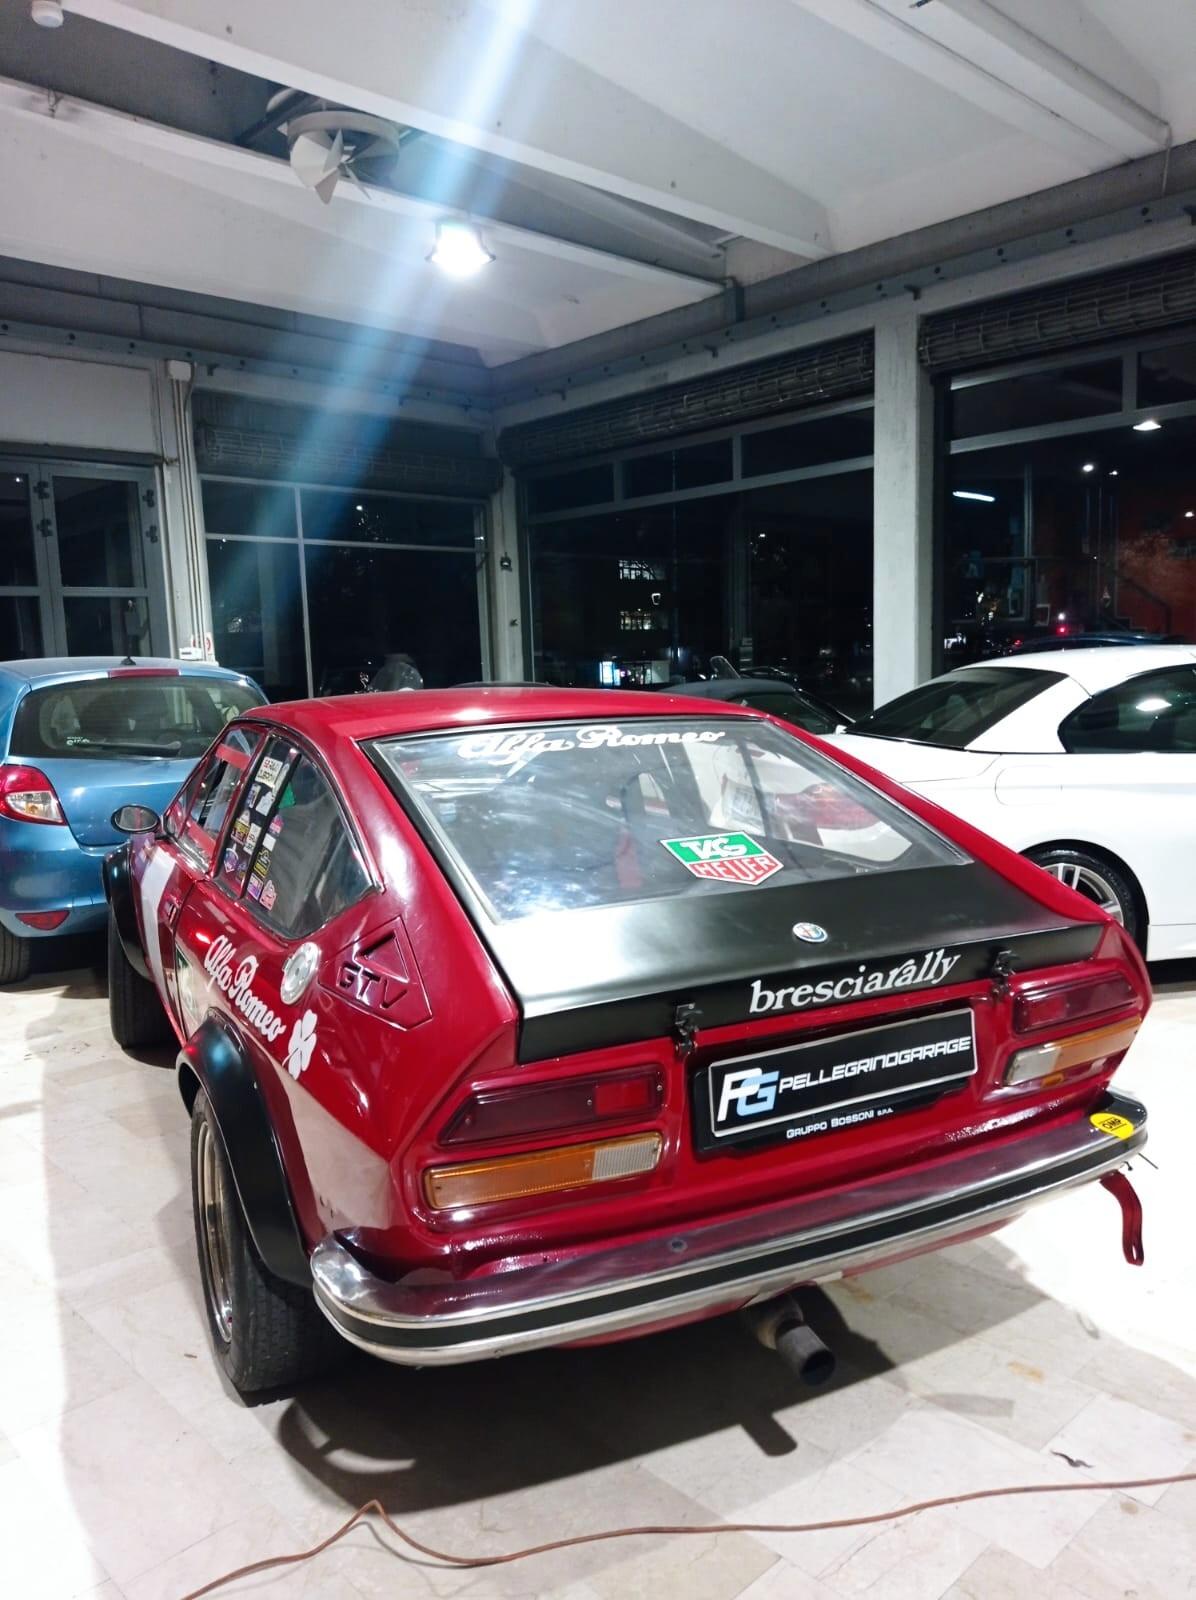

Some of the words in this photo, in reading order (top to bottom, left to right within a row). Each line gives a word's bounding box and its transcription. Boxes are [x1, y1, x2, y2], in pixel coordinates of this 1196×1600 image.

[457, 732, 575, 765] Alfa
[577, 726, 726, 749] Romeo
[680, 836, 748, 862] TAG
[692, 855, 780, 884] HEUER
[204, 935, 236, 992] Alfa
[229, 955, 286, 1042] Romeo
[336, 960, 408, 1009] GTV
[778, 1036, 971, 1093] PELLEGRINOGARAGE
[786, 1121, 828, 1139] GRUPPO
[831, 1109, 875, 1128] BOSSONI
[1102, 1117, 1122, 1130] OMP
